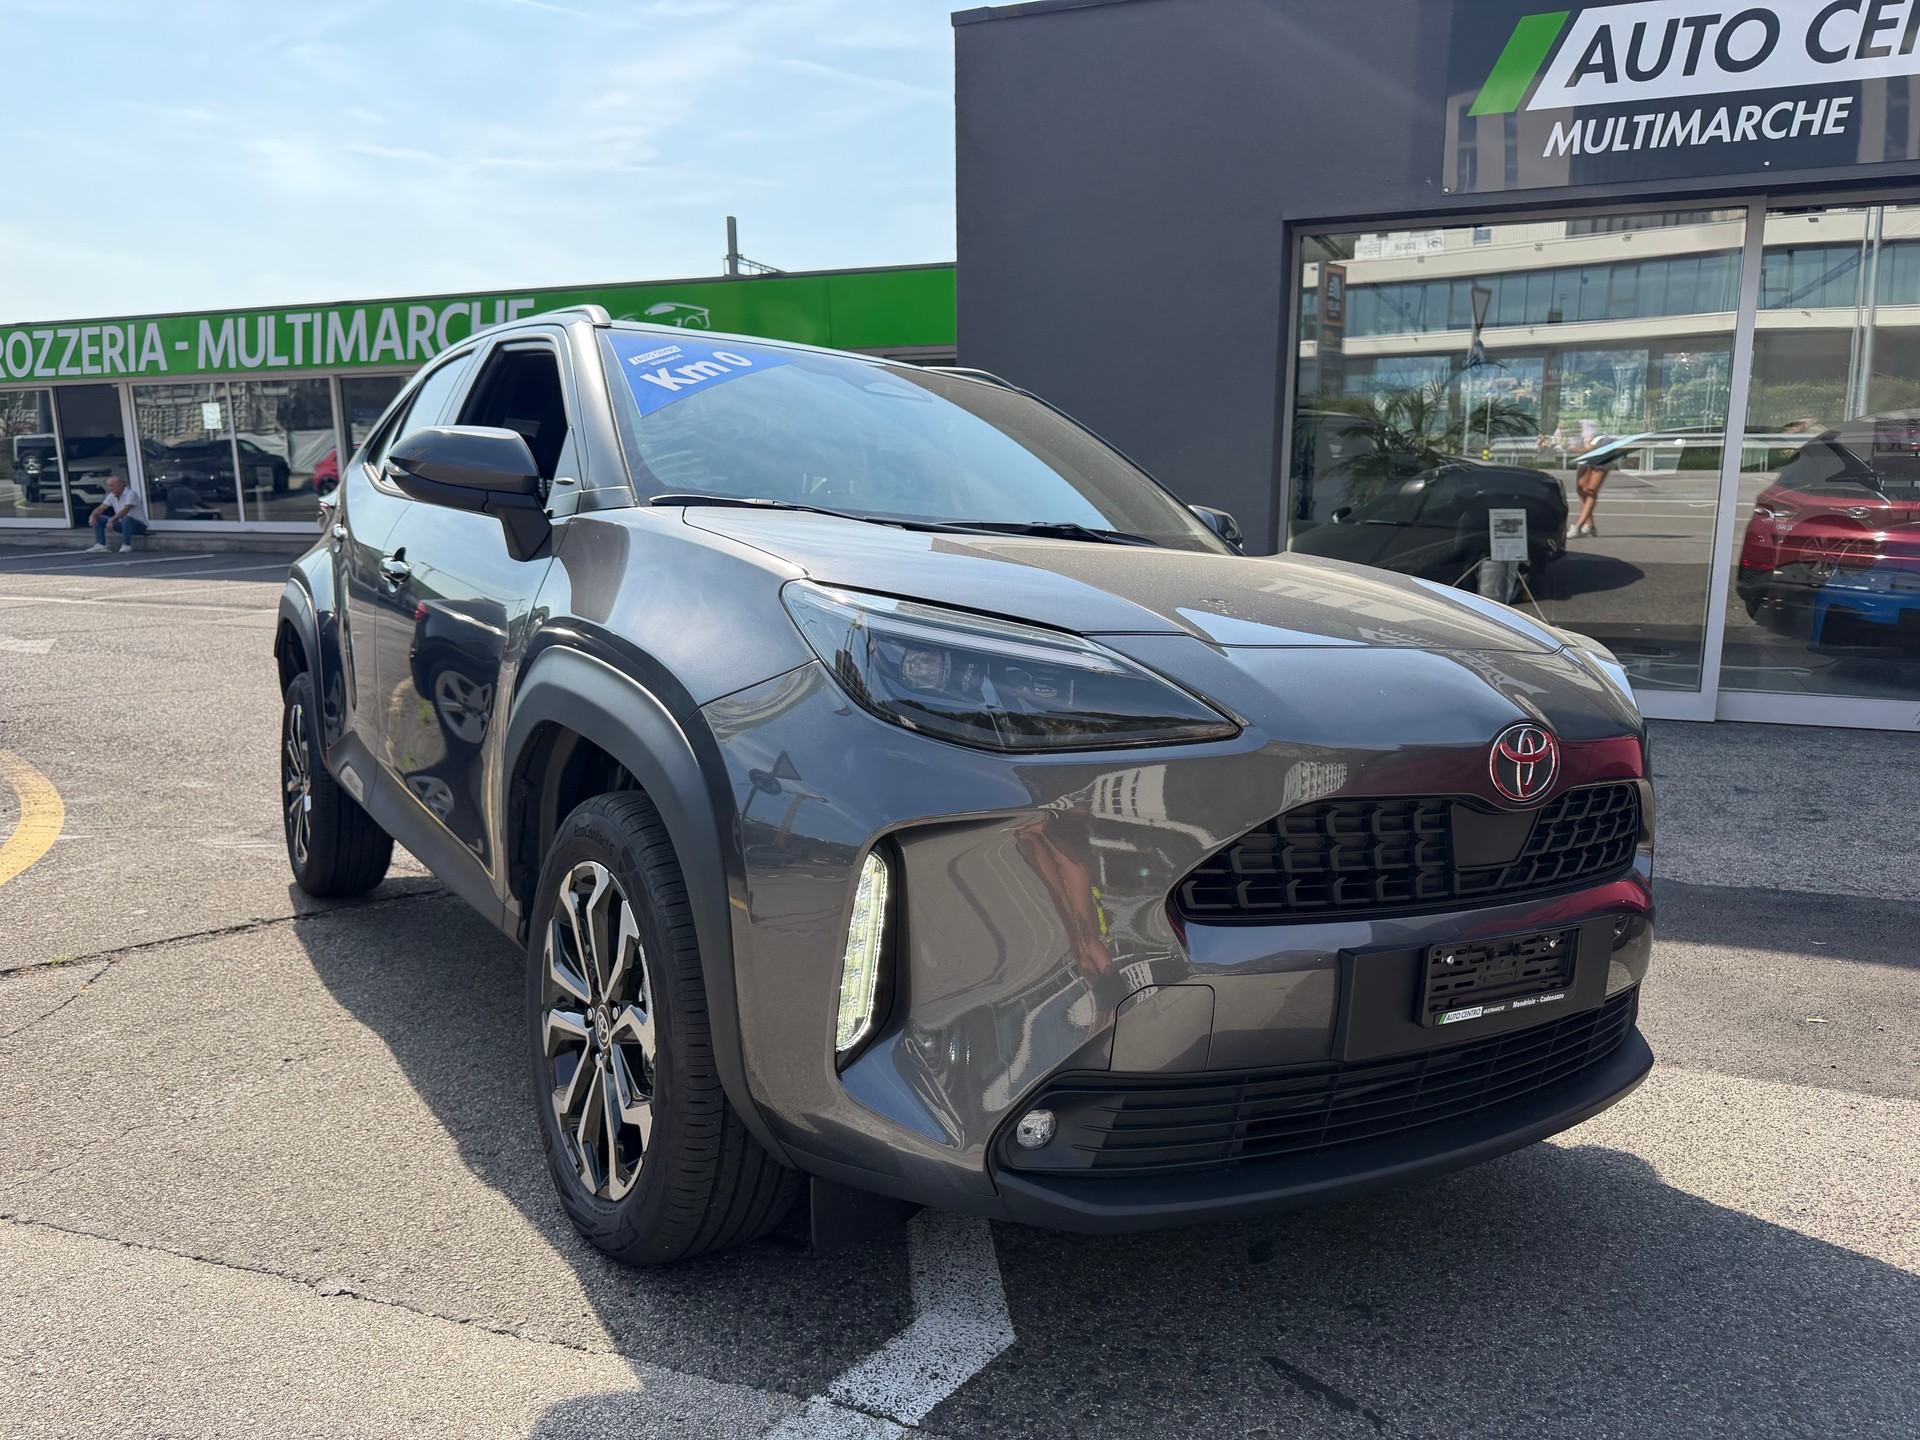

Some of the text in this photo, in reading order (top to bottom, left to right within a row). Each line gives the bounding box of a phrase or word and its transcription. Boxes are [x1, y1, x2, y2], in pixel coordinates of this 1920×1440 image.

[1564, 7, 1781, 88] AUTO
[1542, 96, 1854, 158] MULTIMARCHE
[640, 361, 732, 391] Km
[574, 824, 615, 857] EcoContact 6
[1446, 1012, 1460, 1022] AUTO
[1461, 1008, 1482, 1019] CENTRO
[1512, 998, 1536, 1009] Mendrisio
[1540, 993, 1565, 1003] Cadenazzo
